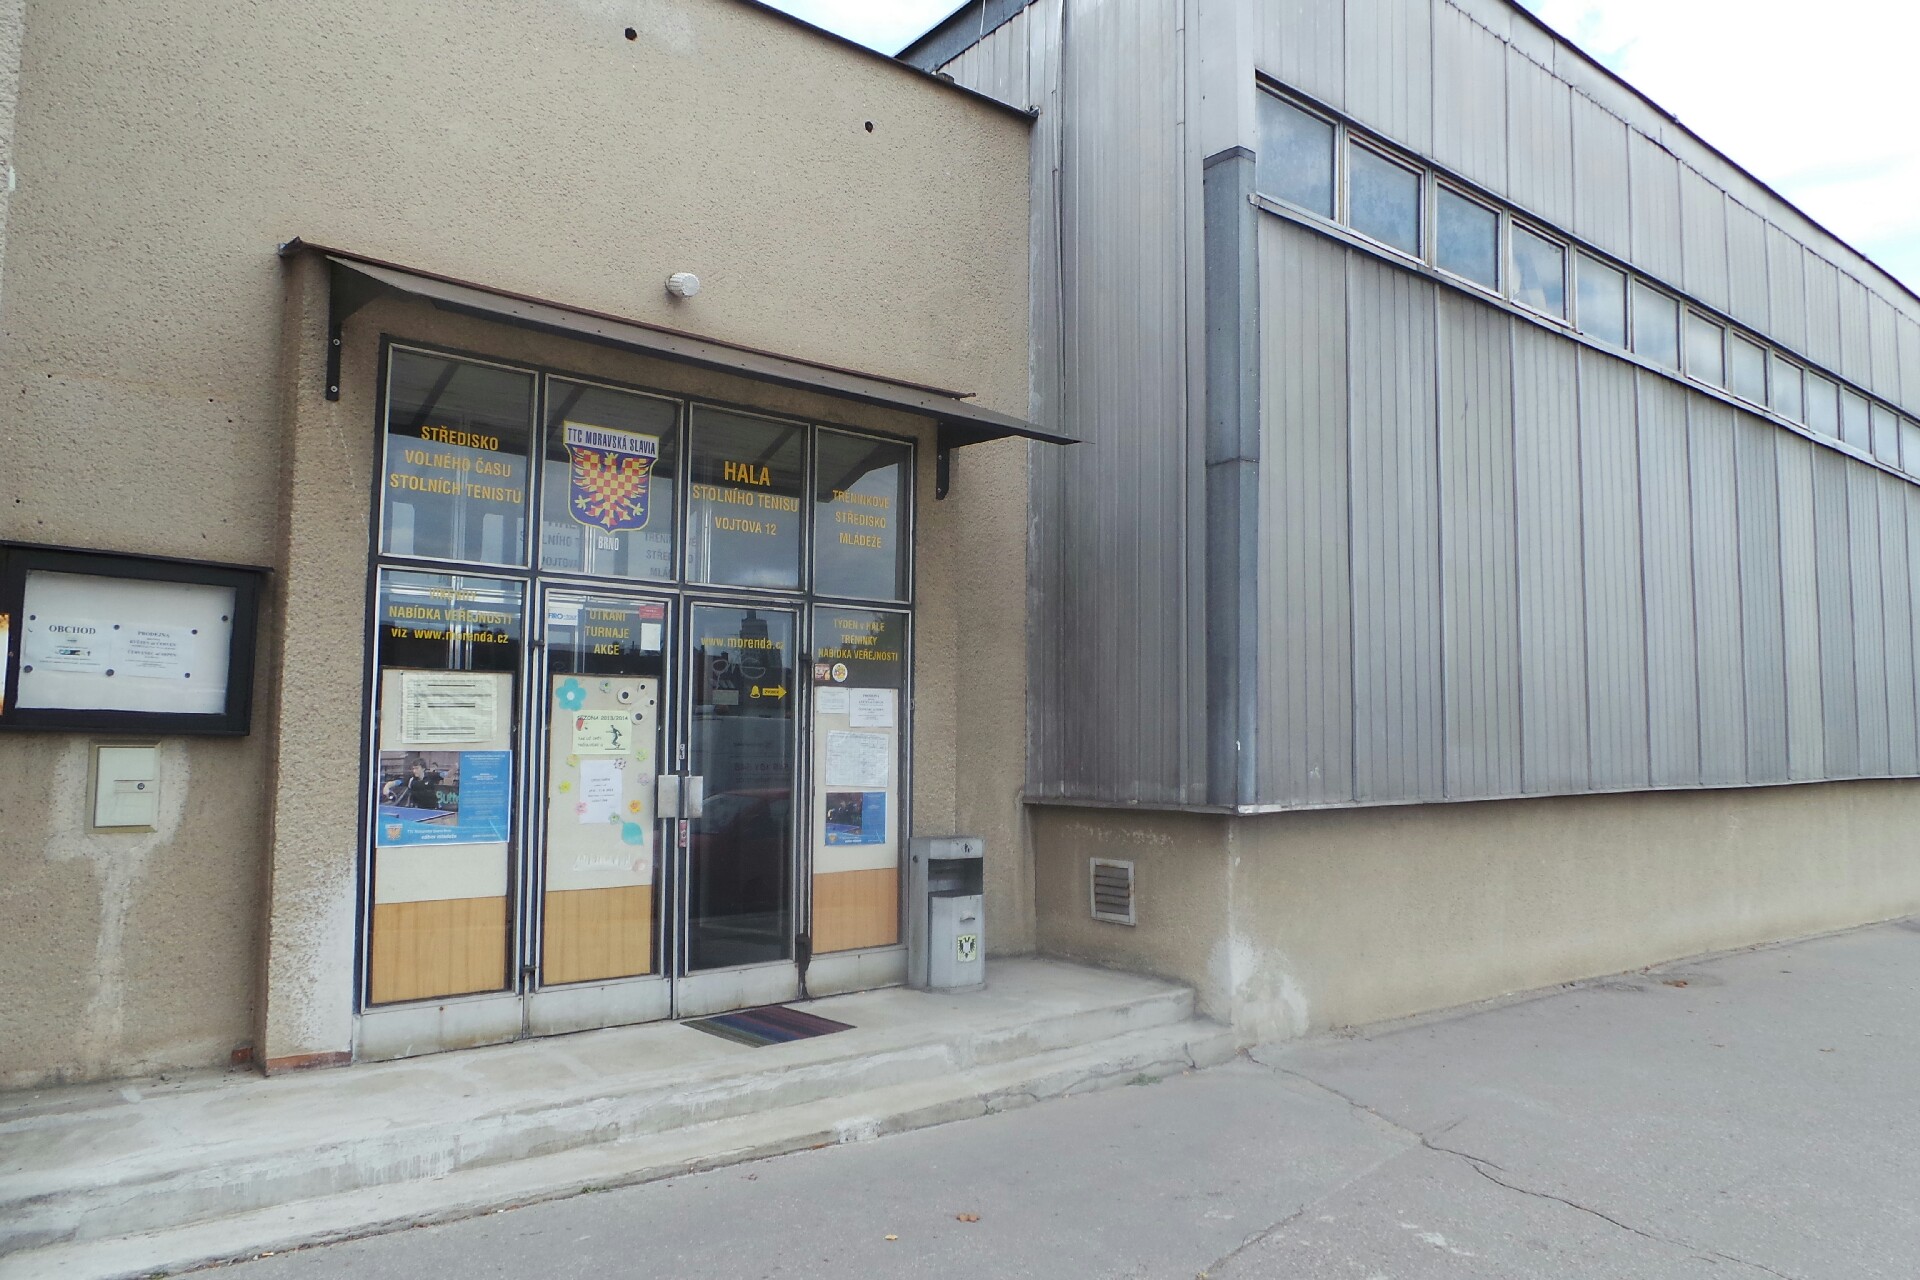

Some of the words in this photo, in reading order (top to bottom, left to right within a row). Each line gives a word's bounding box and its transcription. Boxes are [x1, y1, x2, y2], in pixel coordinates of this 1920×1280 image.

[421, 425, 499, 451] STŘEDISKO
[567, 427, 583, 443] TTC
[585, 431, 627, 450] MORAVSKÁ
[629, 438, 656, 455] SLAVIA
[404, 449, 471, 472] VOLNÉHO
[475, 457, 511, 478] ČASU
[724, 460, 771, 487] HALA
[390, 473, 461, 496] STOLNÍCH
[692, 484, 754, 506] STOLNÍHO
[757, 493, 800, 512] TENISU
[714, 516, 762, 534] VOJTOVA
[765, 523, 777, 536] 12
[835, 510, 887, 529] STŘEDISKO
[598, 536, 619, 551] BRNO
[839, 532, 882, 549] MLÁDEŽE
[389, 604, 441, 621] NABÍDKA
[445, 606, 512, 625] VEŘEJNOSTI
[48, 624, 96, 635] OBCHOD
[391, 627, 408, 639] viz
[585, 625, 630, 639] TURNAJE
[866, 621, 885, 632] HALE
[594, 644, 620, 656] AKCE
[818, 646, 852, 659] NABÍDKA
[854, 648, 898, 661] VEŘEJNOSTI
